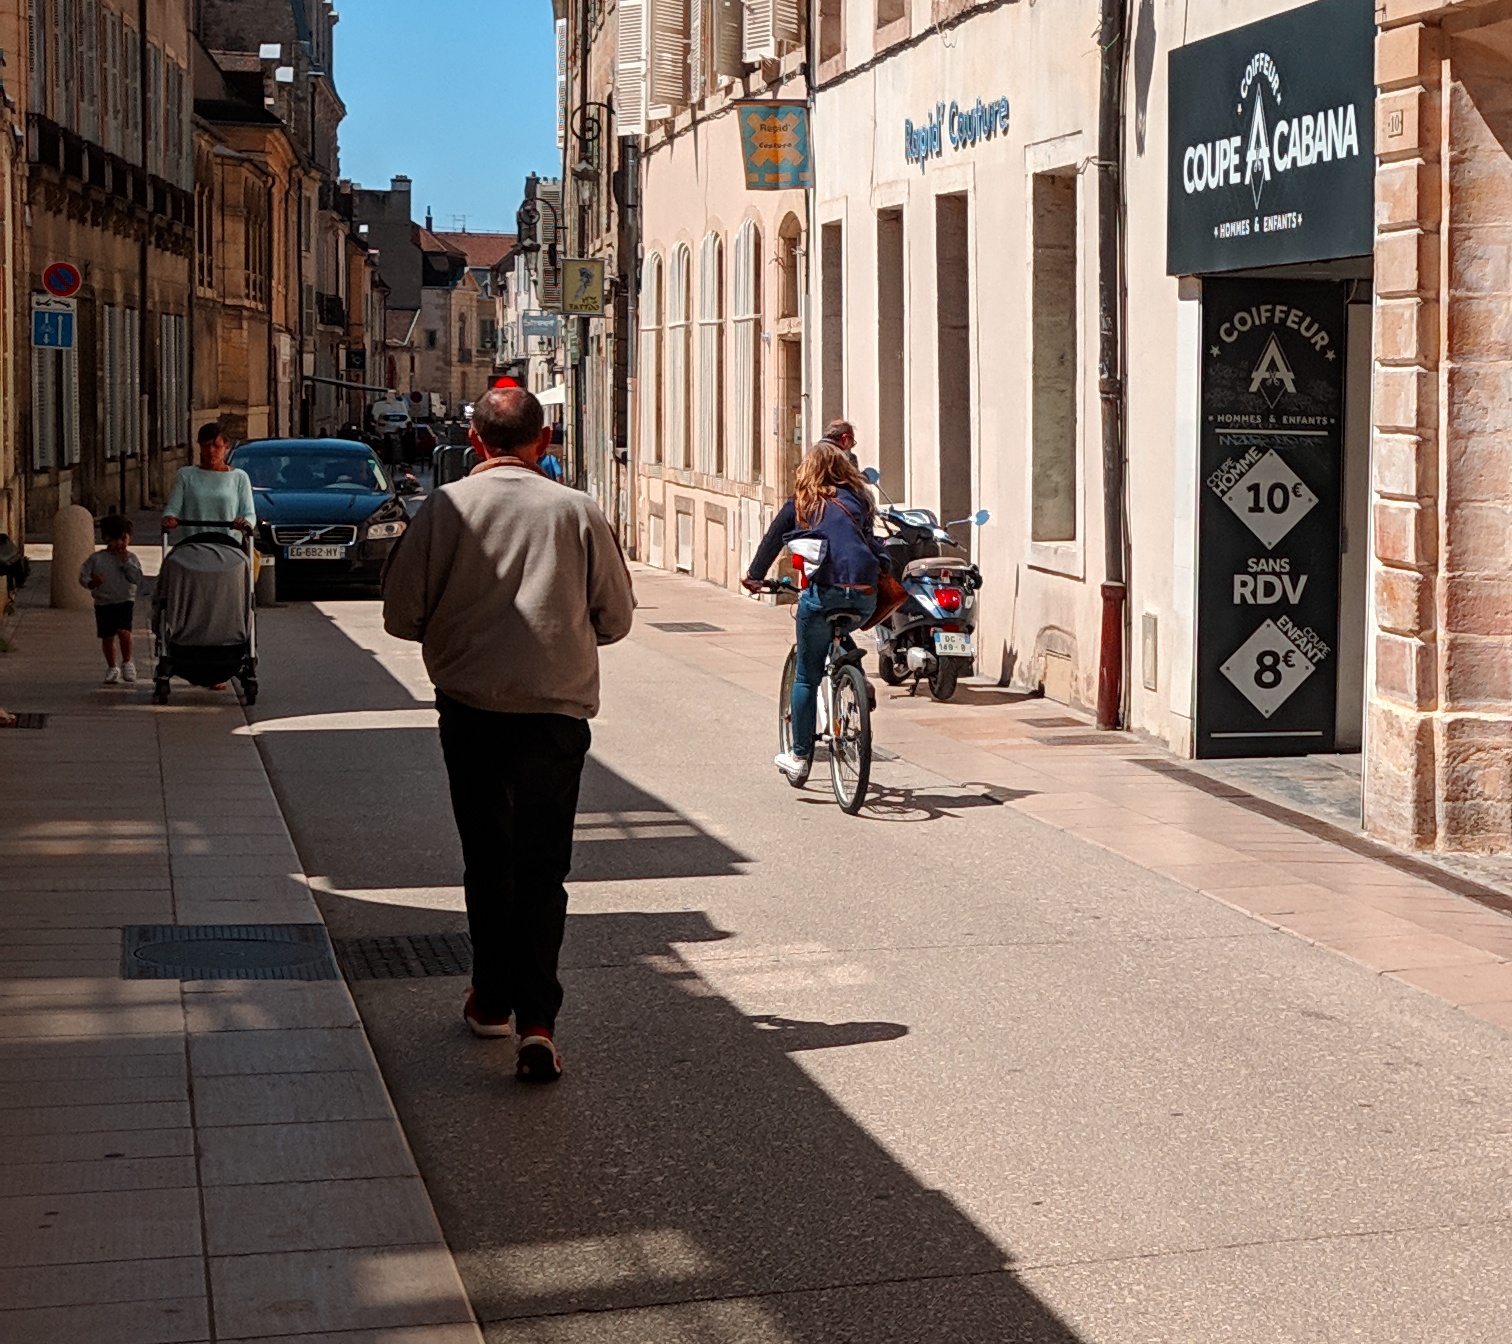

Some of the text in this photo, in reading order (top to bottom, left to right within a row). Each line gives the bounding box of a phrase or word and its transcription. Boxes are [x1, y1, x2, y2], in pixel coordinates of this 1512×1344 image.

[1240, 52, 1280, 99] COIFFEUR
[948, 96, 1009, 146] Couture
[1183, 135, 1242, 194] COUPE
[1273, 104, 1359, 172] CABANA
[1219, 212, 1297, 238] HOMMES & ENFANTS
[1219, 304, 1330, 352] COIFFEUR
[1217, 413, 1328, 425] HOMMES & ENFANTS
[1206, 456, 1237, 488] COUPE
[1212, 445, 1263, 498] HOMME
[1247, 557, 1290, 573] SANS
[1232, 574, 1308, 605] RDV
[1276, 614, 1327, 664] ENFANT
[1302, 626, 1332, 657] COUPE
